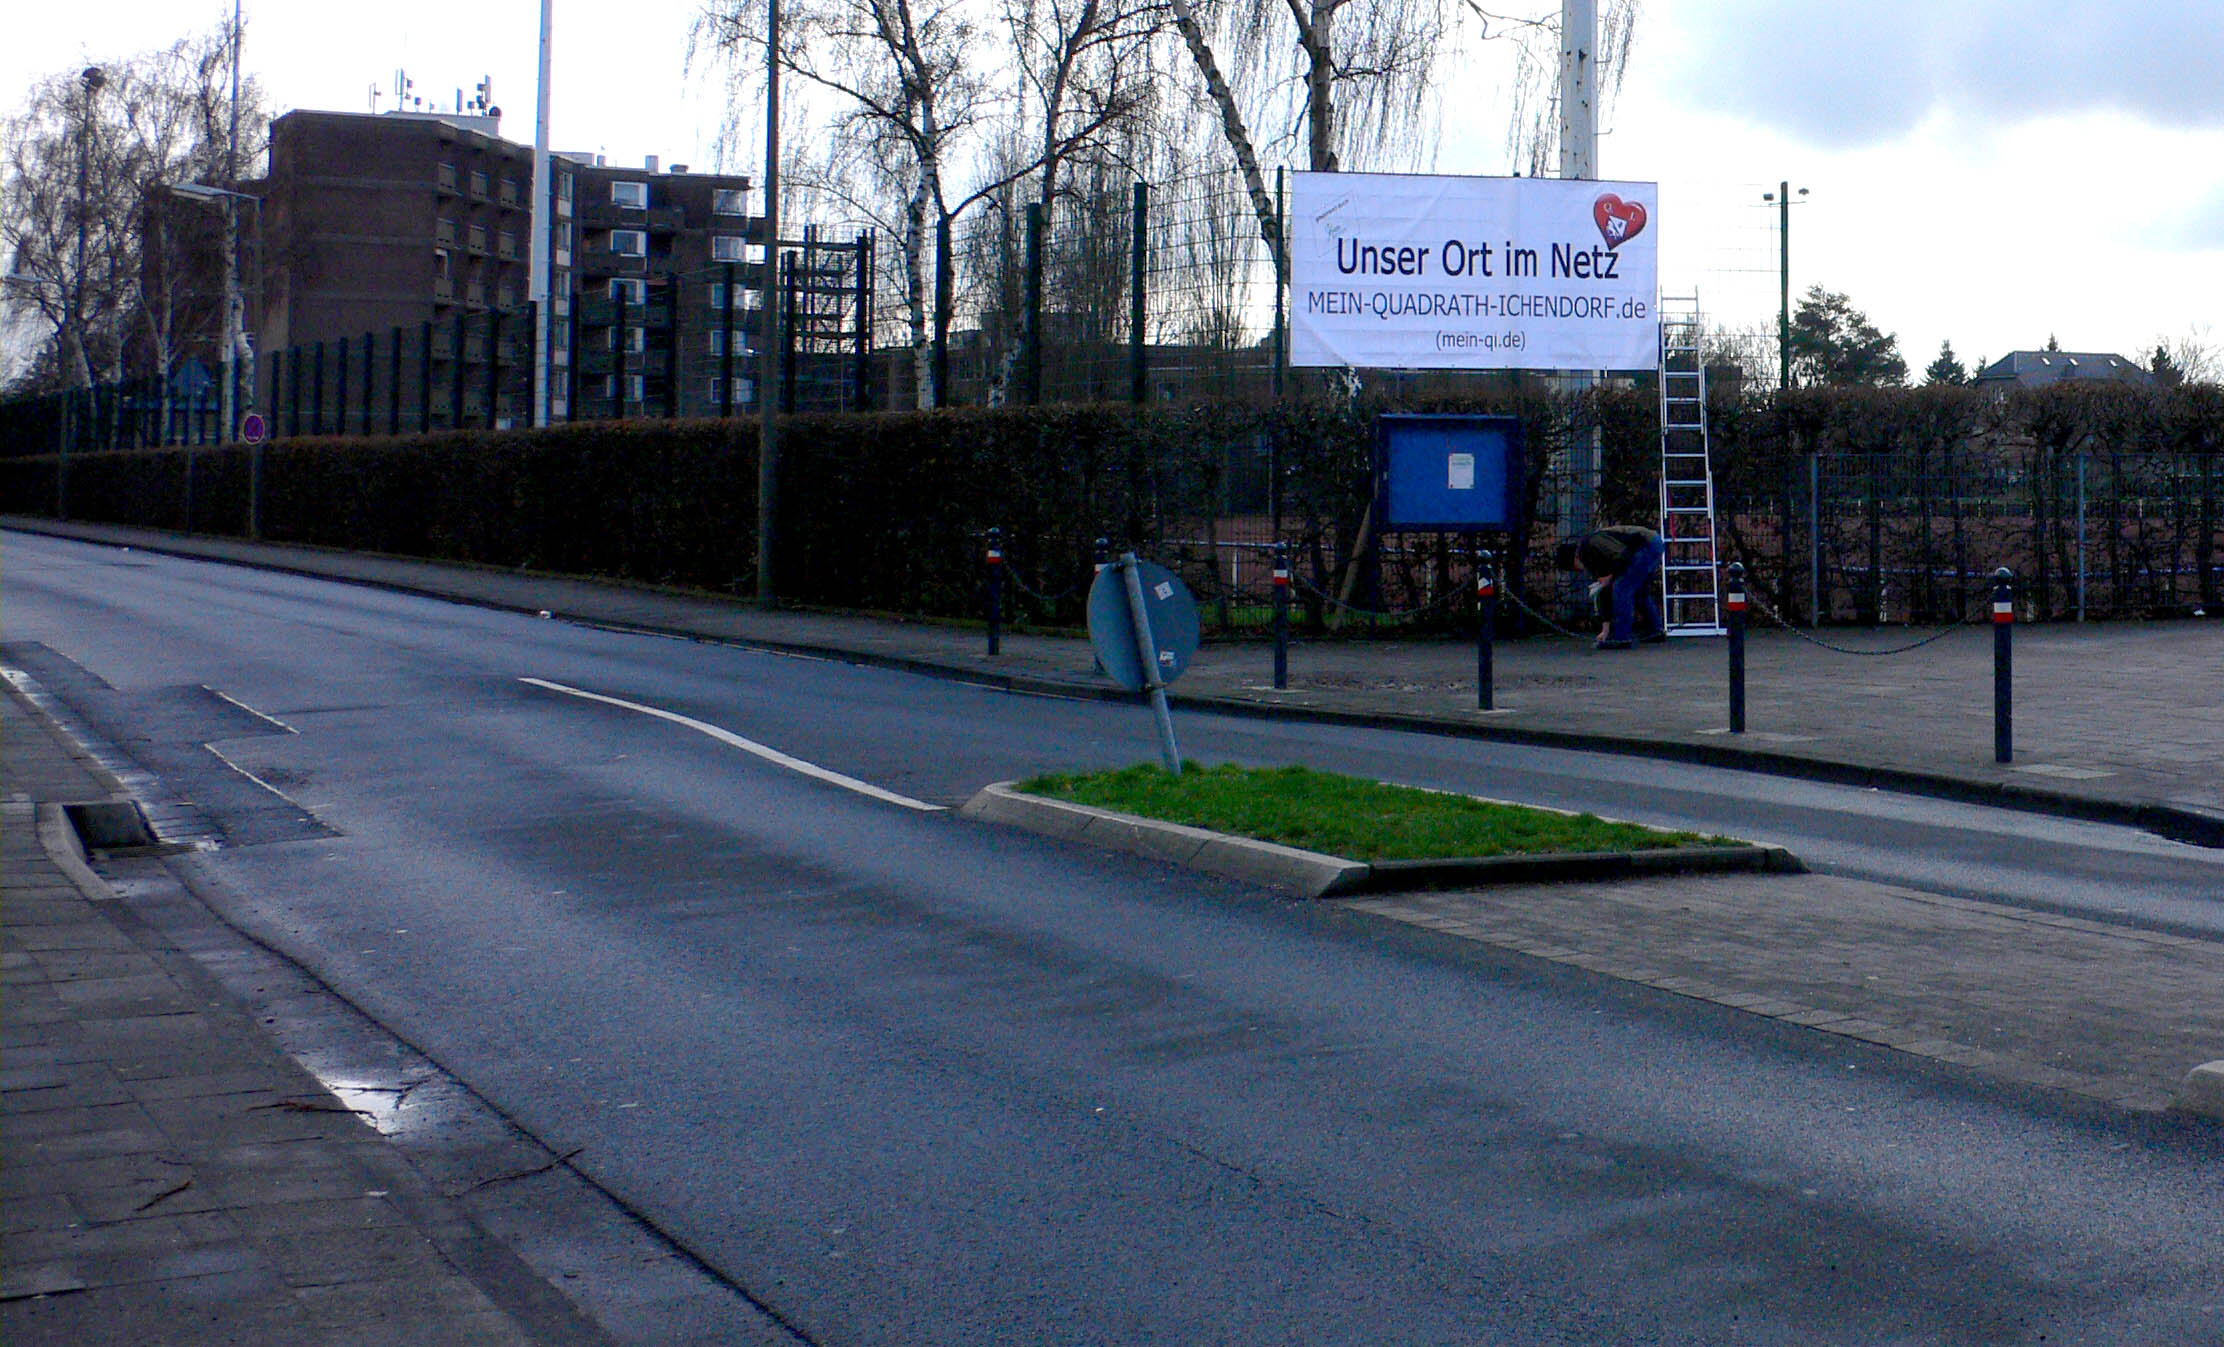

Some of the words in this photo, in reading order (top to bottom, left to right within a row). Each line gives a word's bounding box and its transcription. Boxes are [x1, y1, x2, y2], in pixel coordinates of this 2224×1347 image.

[1337, 237, 1430, 276] Unser
[1442, 240, 1493, 277] Ort
[1505, 241, 1538, 278] im
[1551, 242, 1619, 280] Netz
[1308, 291, 1646, 319] MEIN-QUADRATH-ICHENDORF.de
[1436, 330, 1526, 353] (mein-qi.de)
